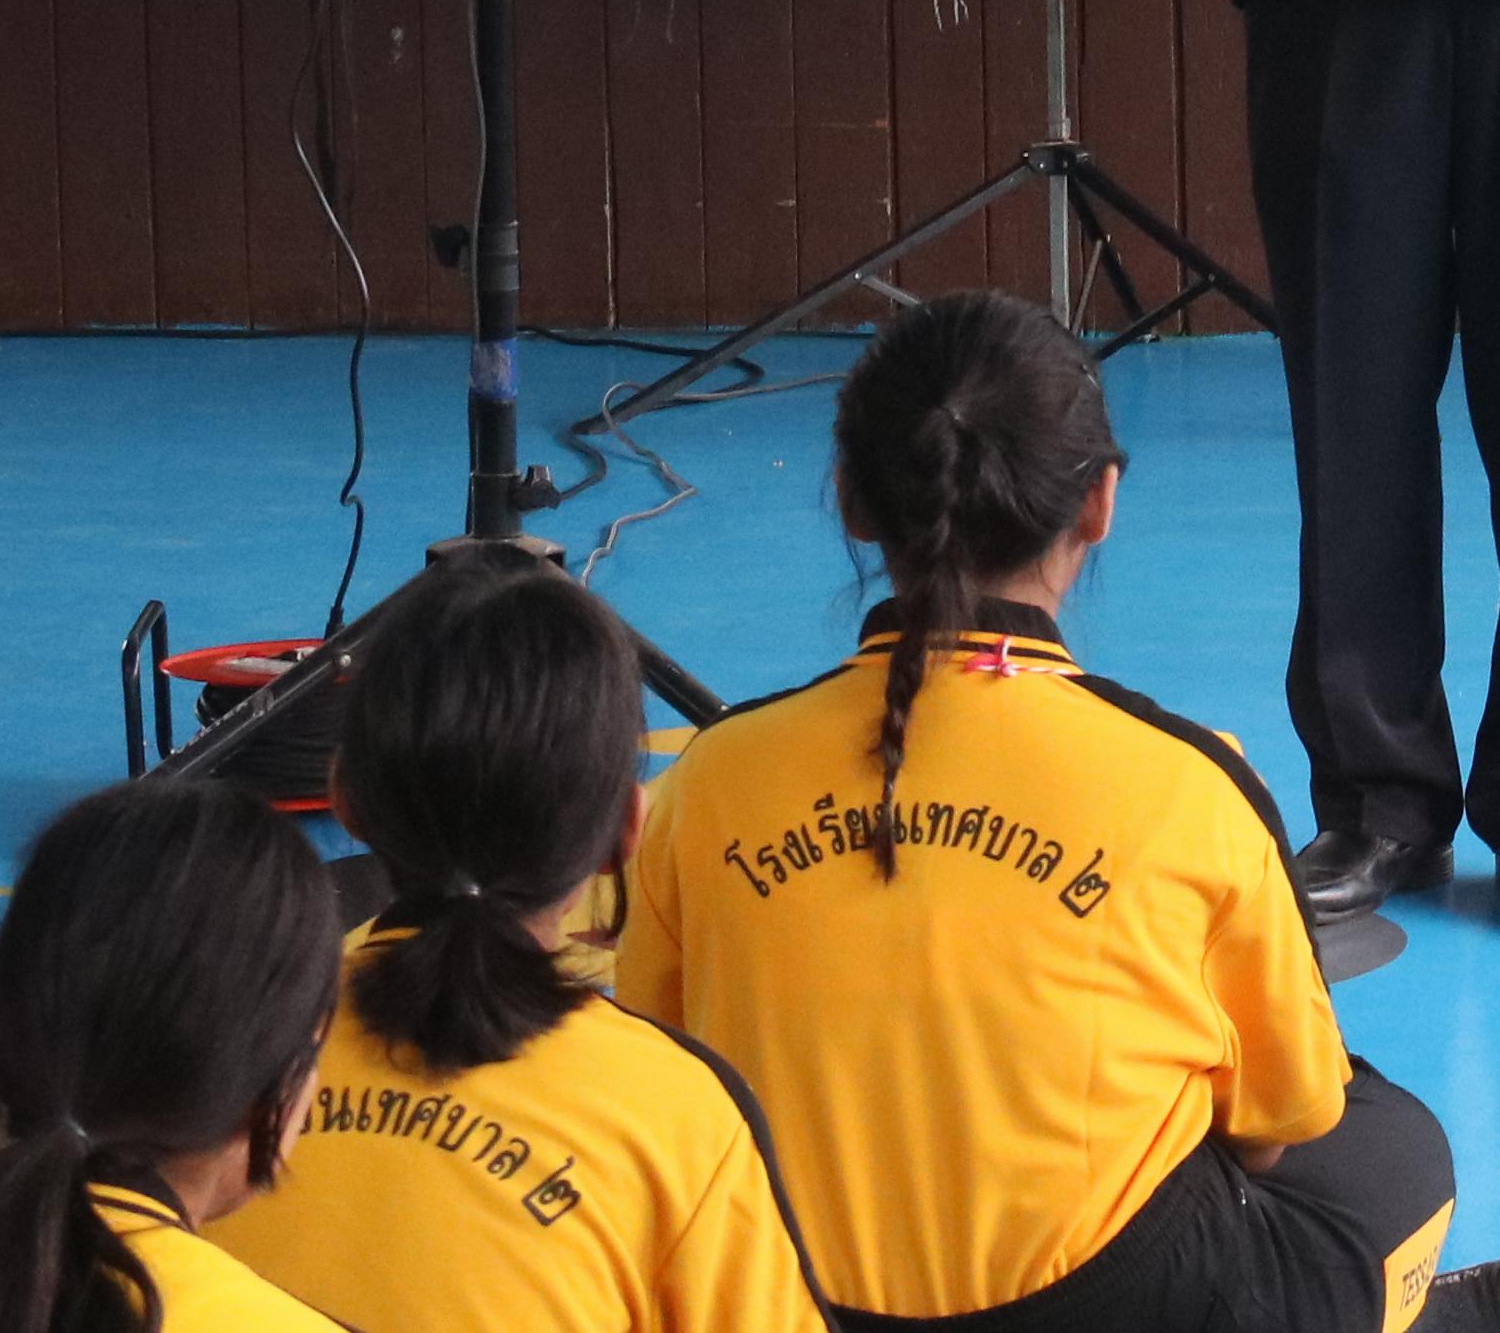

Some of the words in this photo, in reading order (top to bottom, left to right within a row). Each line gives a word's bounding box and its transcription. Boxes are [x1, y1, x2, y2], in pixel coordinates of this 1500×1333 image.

[1058, 848, 1112, 919] ๒
[298, 1085, 532, 1181] นเทศบาล
[521, 1156, 582, 1228] ๒
